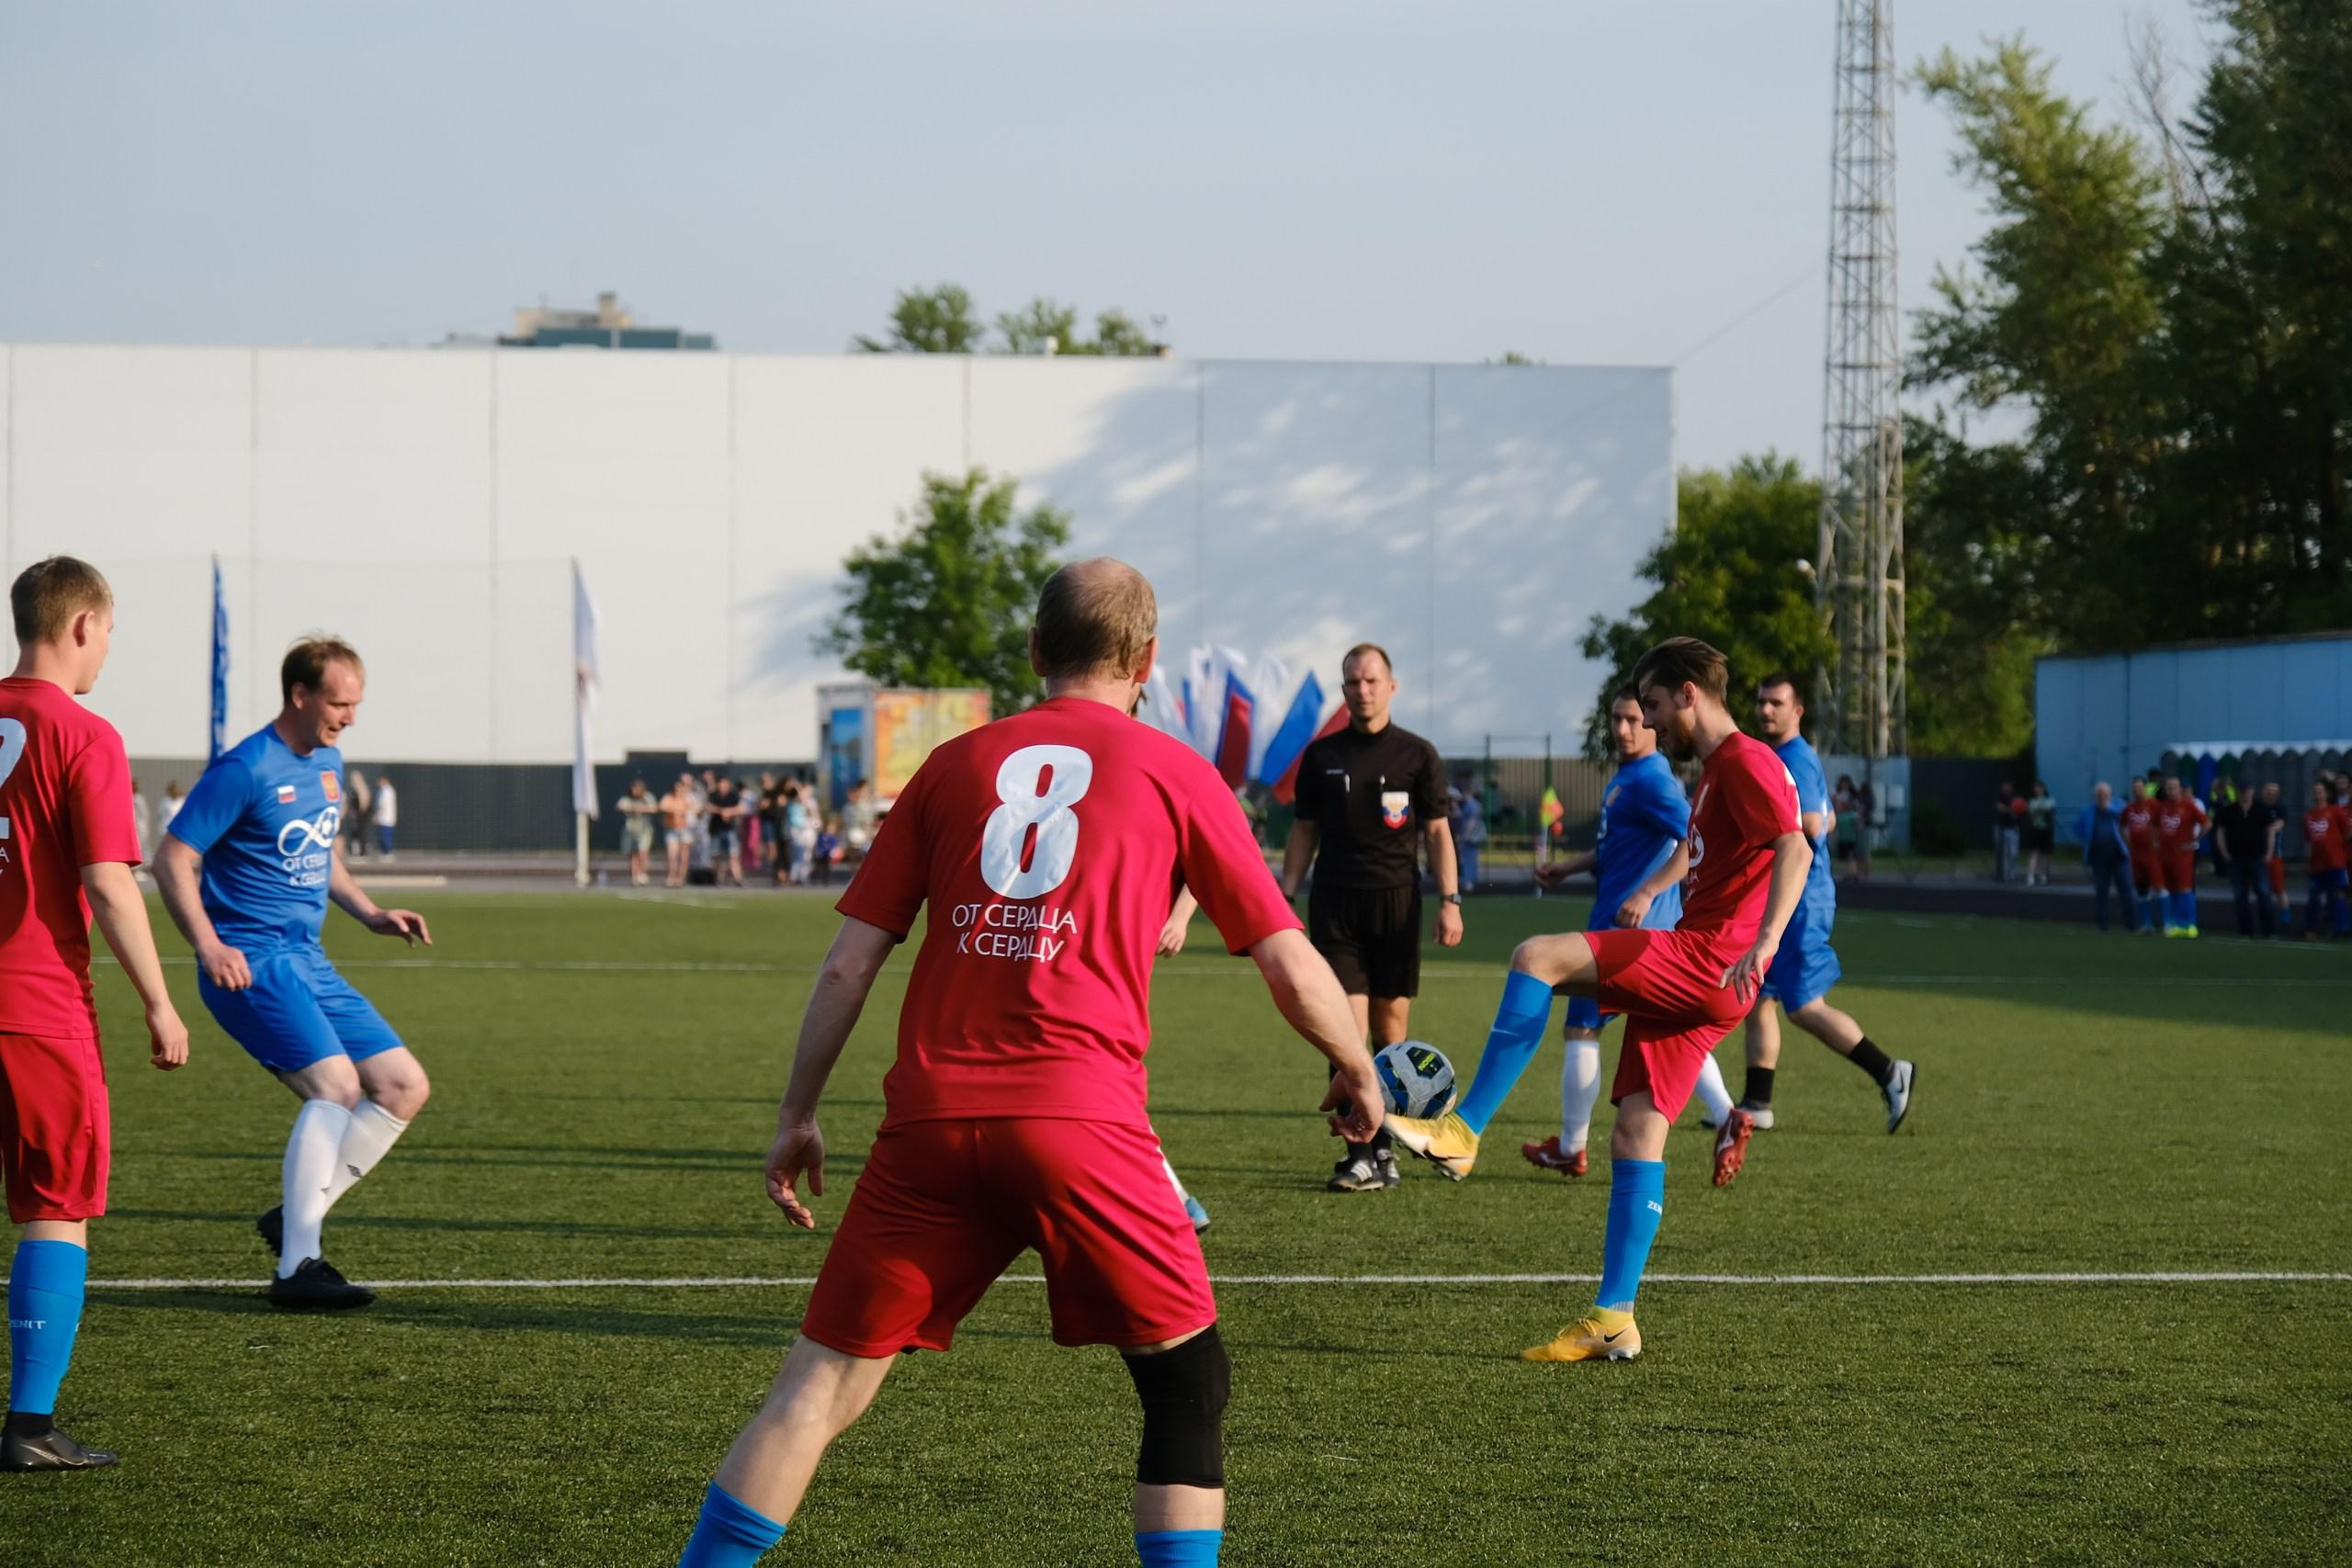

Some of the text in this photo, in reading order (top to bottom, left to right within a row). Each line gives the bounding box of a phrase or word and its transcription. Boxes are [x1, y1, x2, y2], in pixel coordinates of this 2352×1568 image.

[980, 744, 1093, 899] 8
[952, 904, 1078, 934] ОТ СЕРДЦА
[956, 931, 1065, 964] К СЕРДЦУ
